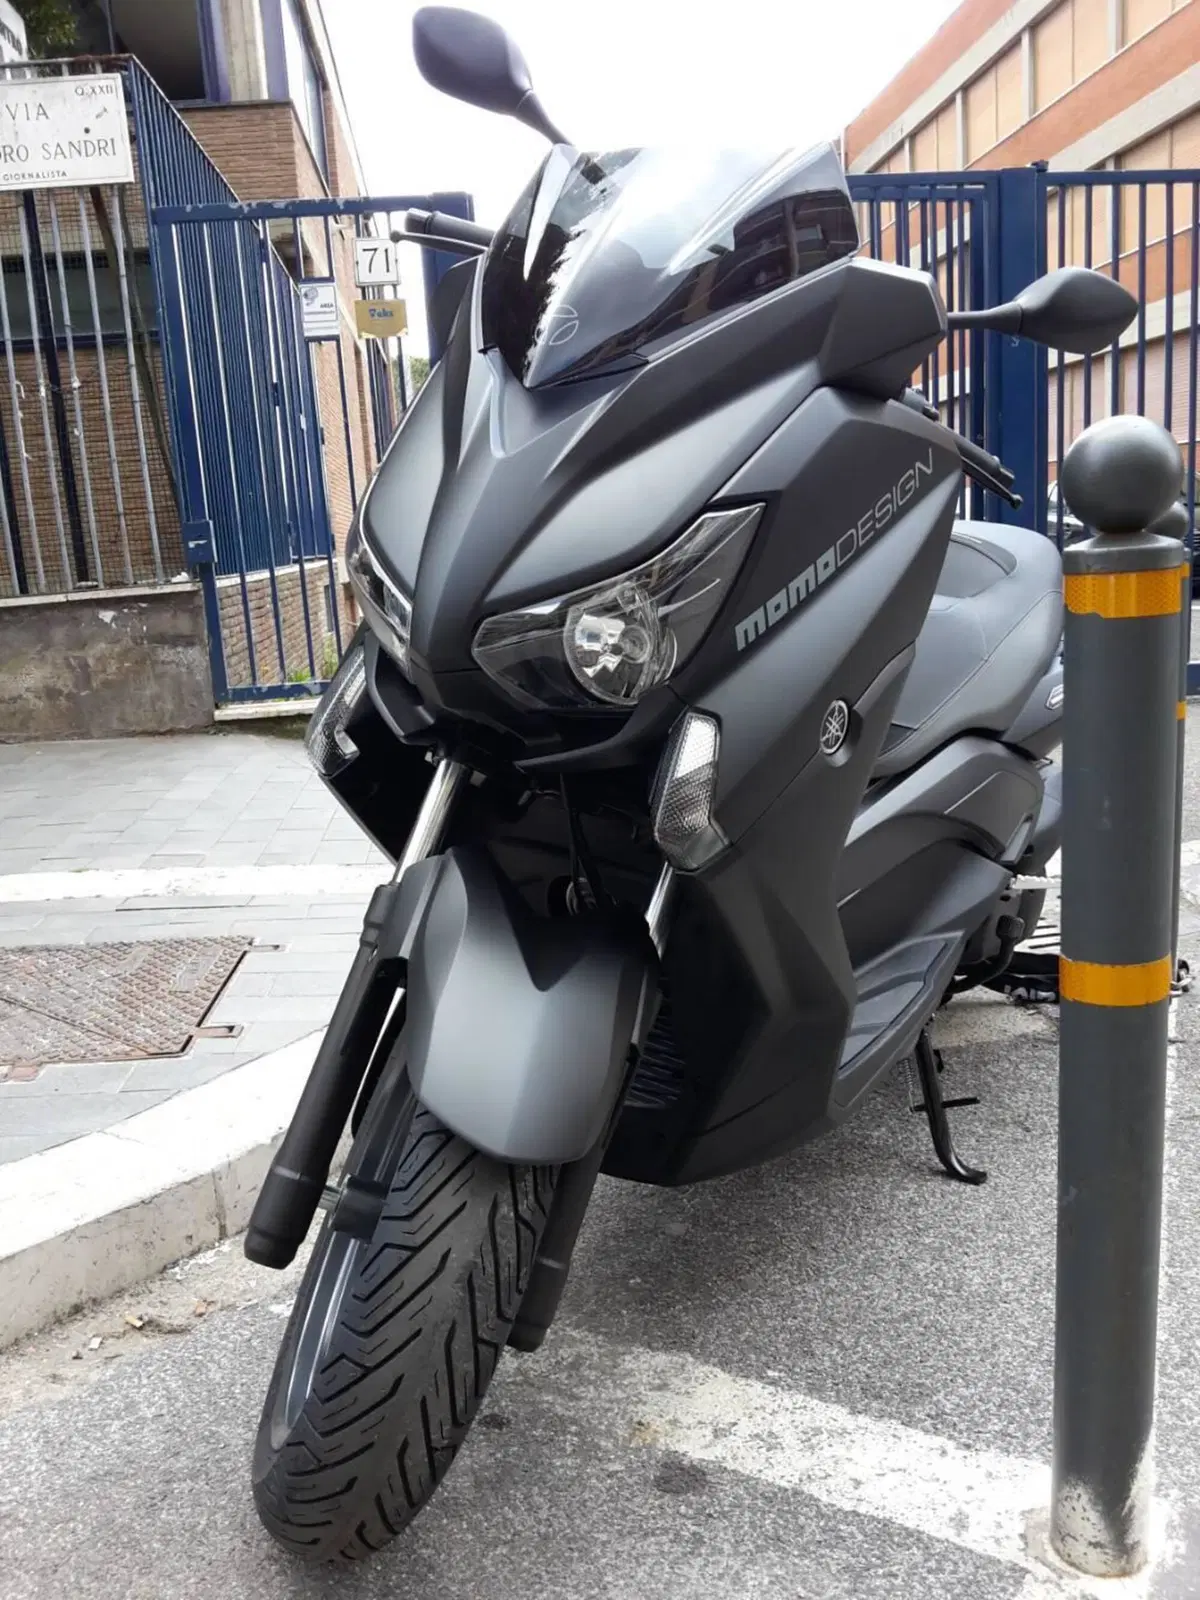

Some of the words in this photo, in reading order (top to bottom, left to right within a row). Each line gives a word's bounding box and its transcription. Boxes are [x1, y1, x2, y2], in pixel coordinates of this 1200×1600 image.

[5, 102, 50, 121] VIA
[0, 143, 29, 163] RO
[41, 137, 117, 161] SANDRI
[3, 170, 68, 181] GIORNALISTA
[362, 247, 390, 274] 71
